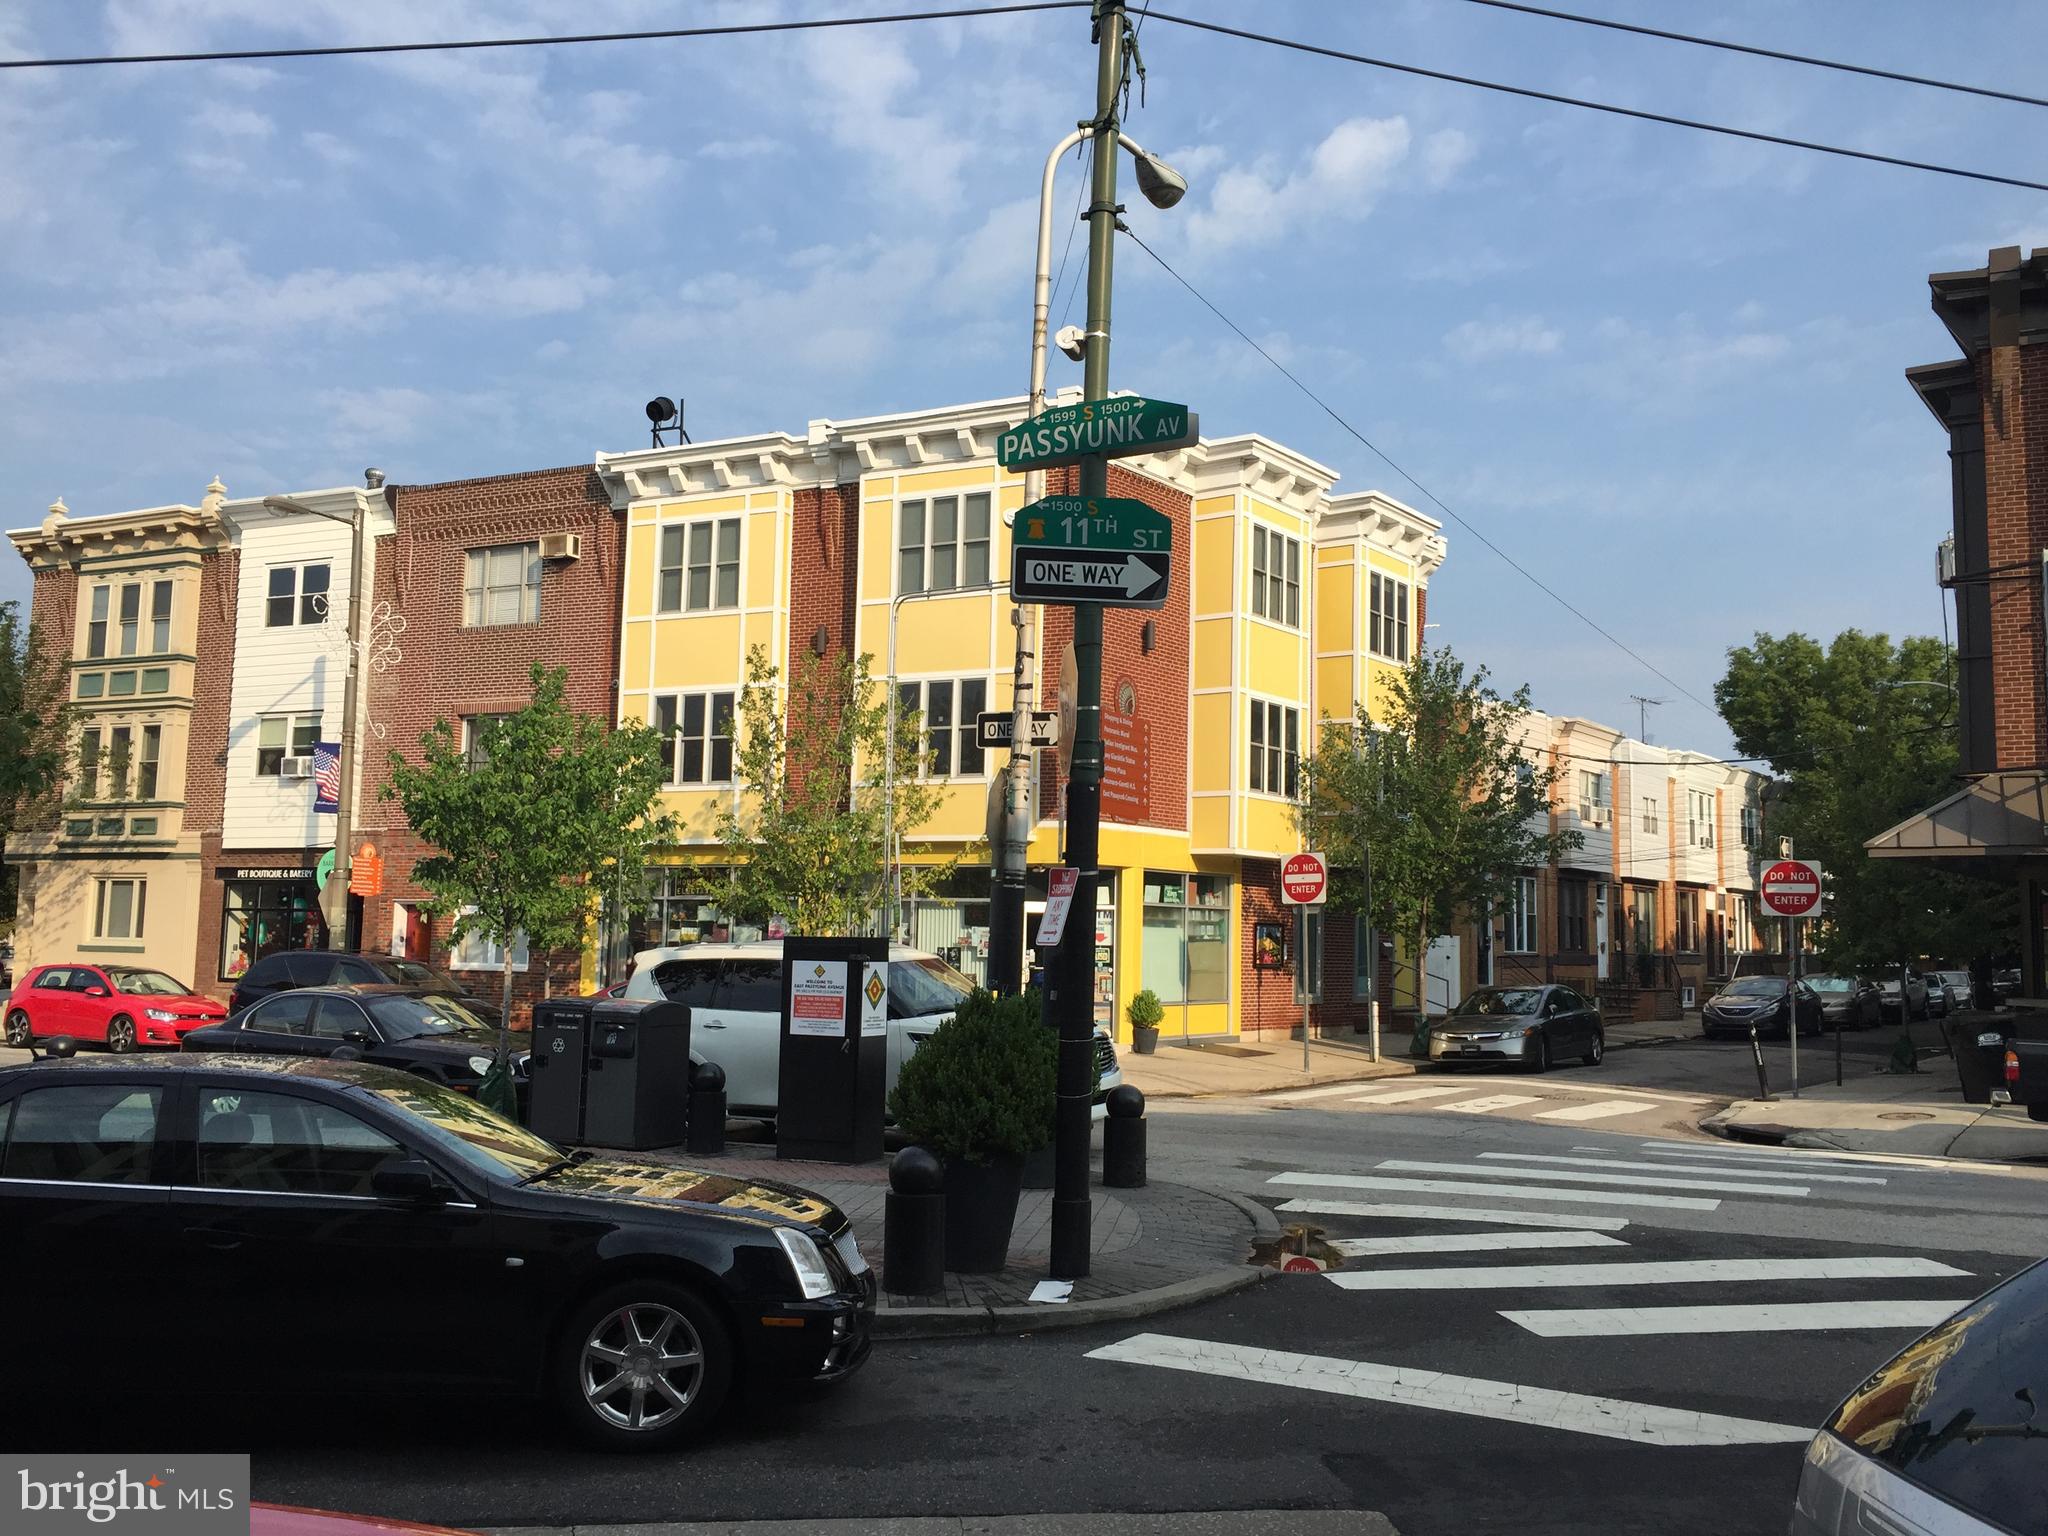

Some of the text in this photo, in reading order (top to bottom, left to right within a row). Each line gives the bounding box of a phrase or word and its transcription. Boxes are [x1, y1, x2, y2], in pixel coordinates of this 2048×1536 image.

[1050, 401, 1130, 424] 1599 S 1500
[1004, 412, 1180, 462] PASSYUNK AV
[1050, 500, 1099, 516] 1500 S
[1060, 516, 1163, 548] 11TH ST
[1032, 562, 1125, 585] ONE WAY
[988, 723, 1012, 737] ONE
[237, 869, 314, 878] PET BOUTIQUE & BAKERY
[1288, 863, 1318, 872] DO NOT
[1770, 872, 1811, 880] DO NOT
[1052, 884, 1073, 894] STOPPING
[1291, 884, 1316, 894] ENTER
[1774, 896, 1808, 905] ENTER
